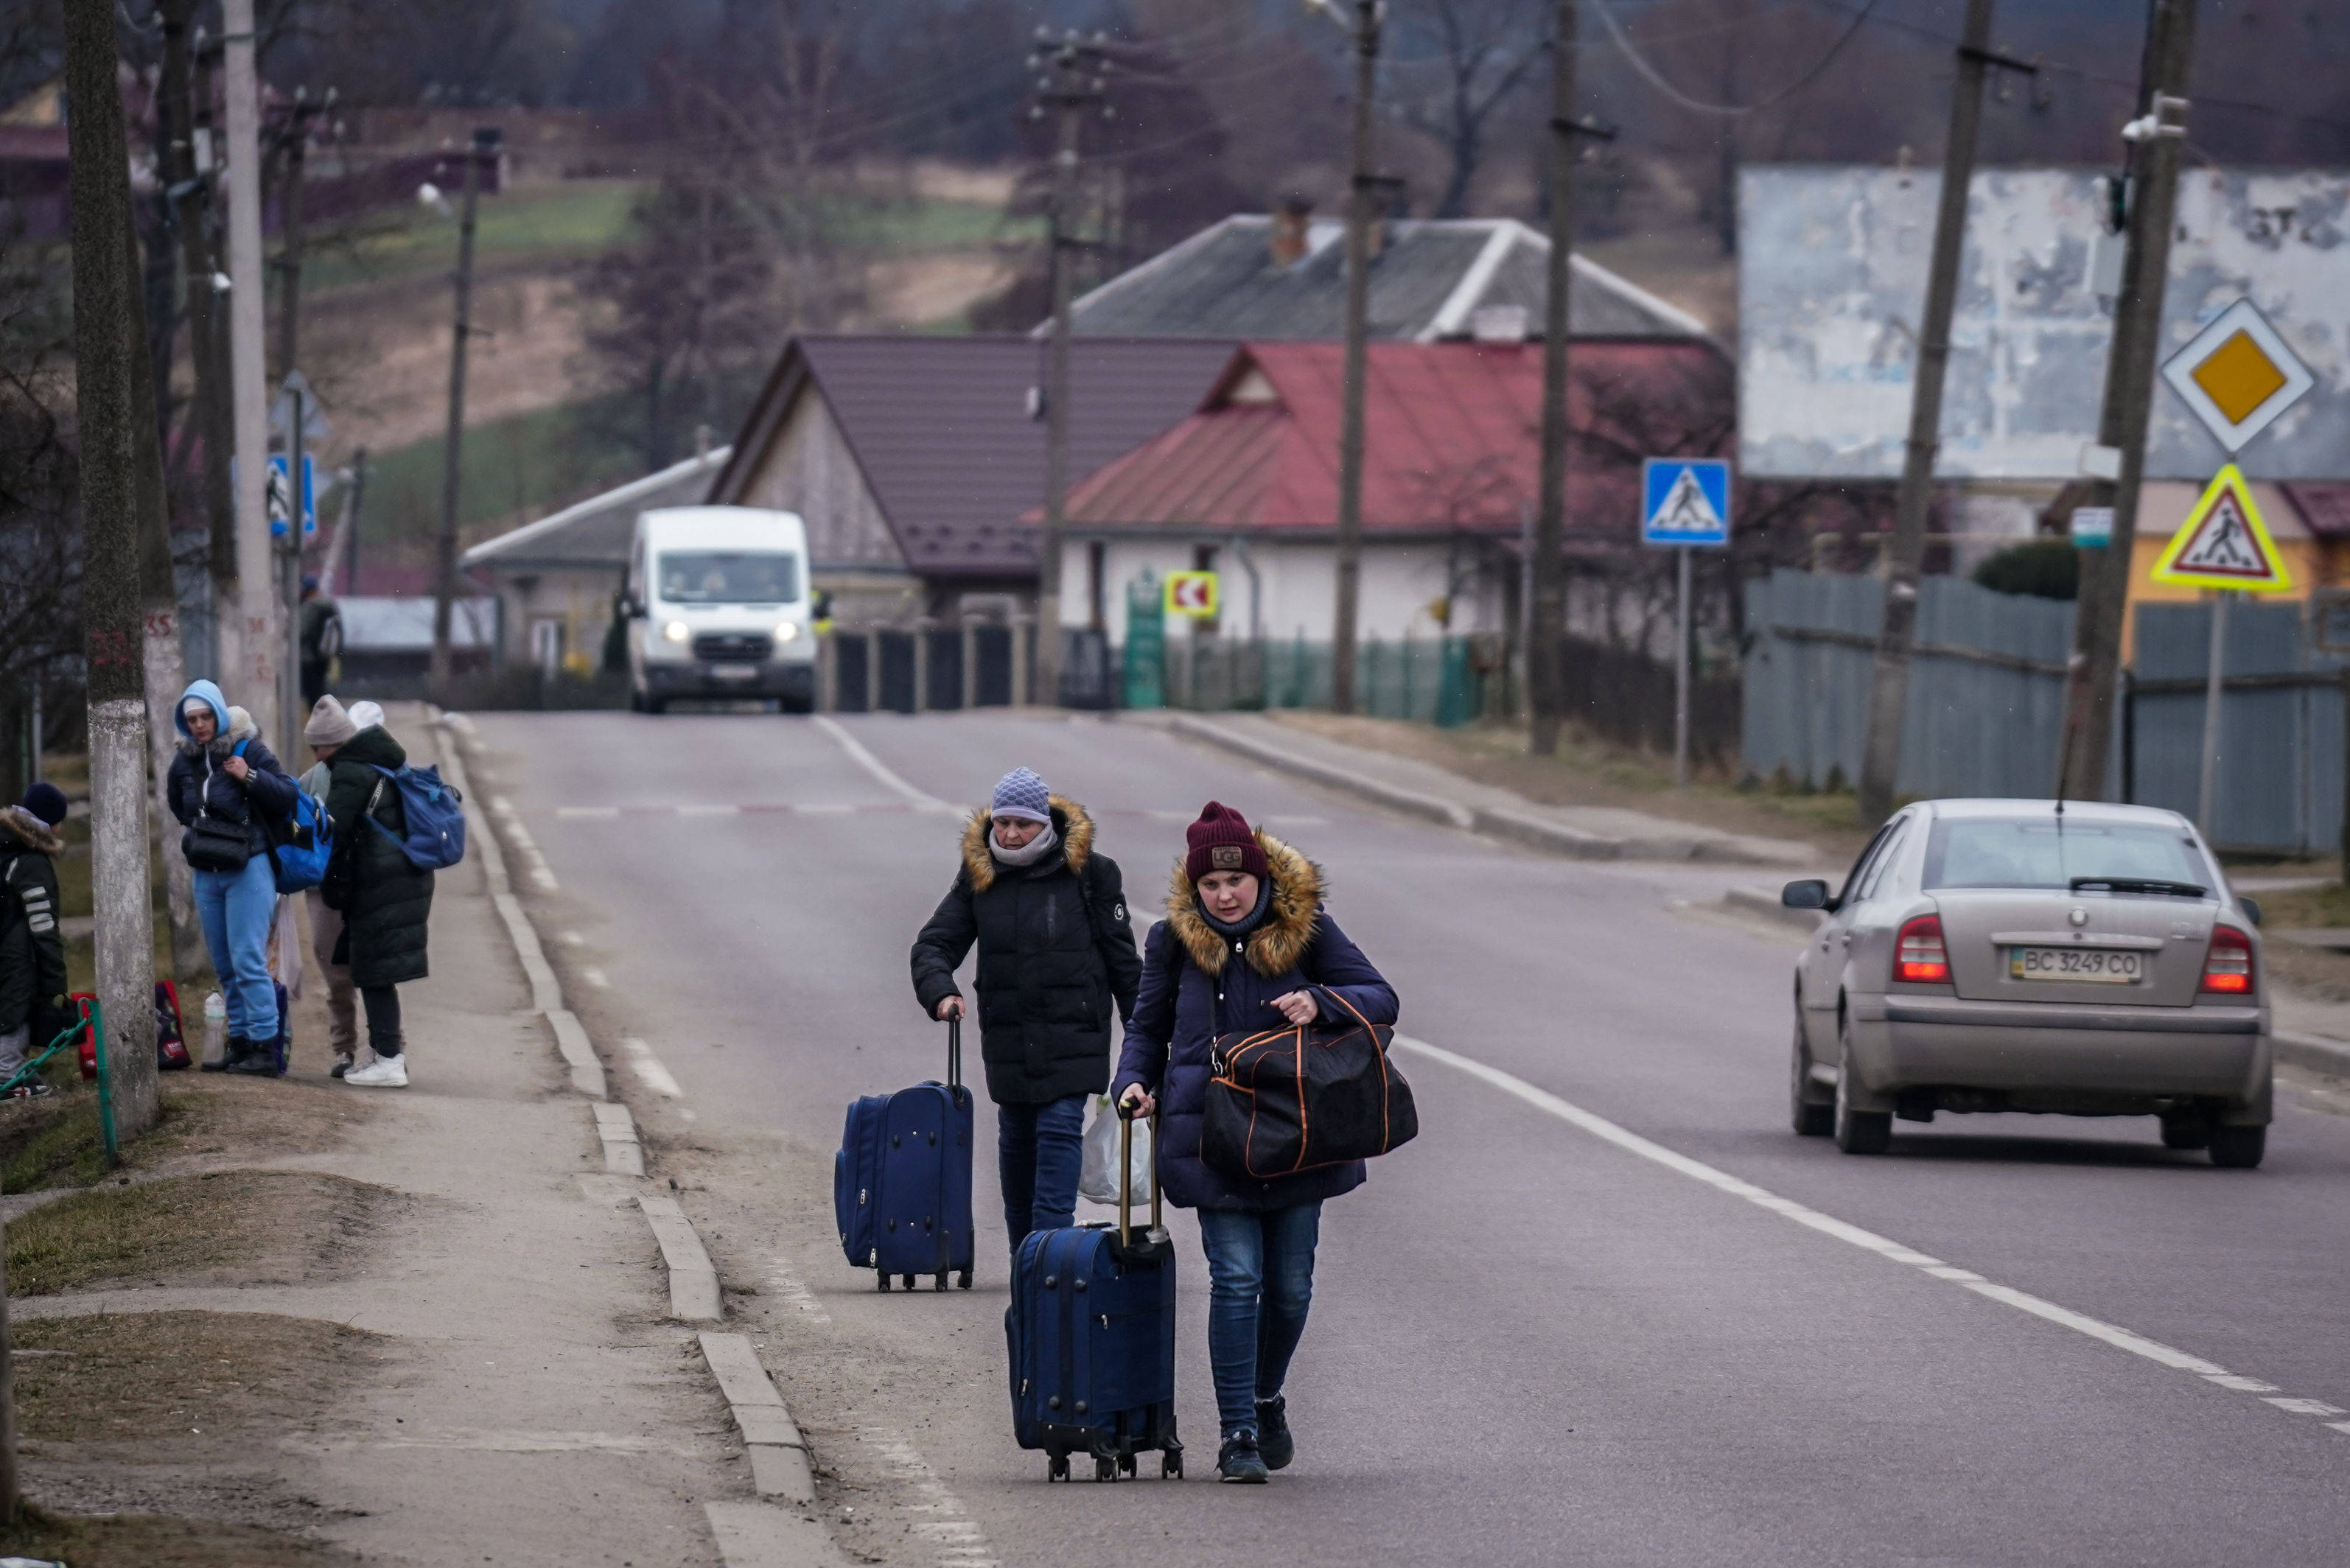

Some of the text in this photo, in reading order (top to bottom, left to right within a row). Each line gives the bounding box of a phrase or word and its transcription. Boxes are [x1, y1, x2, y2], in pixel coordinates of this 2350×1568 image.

[145, 614, 171, 637] 35
[1214, 850, 1241, 863] UGG
[2025, 951, 2136, 974] BC 3249 CO
